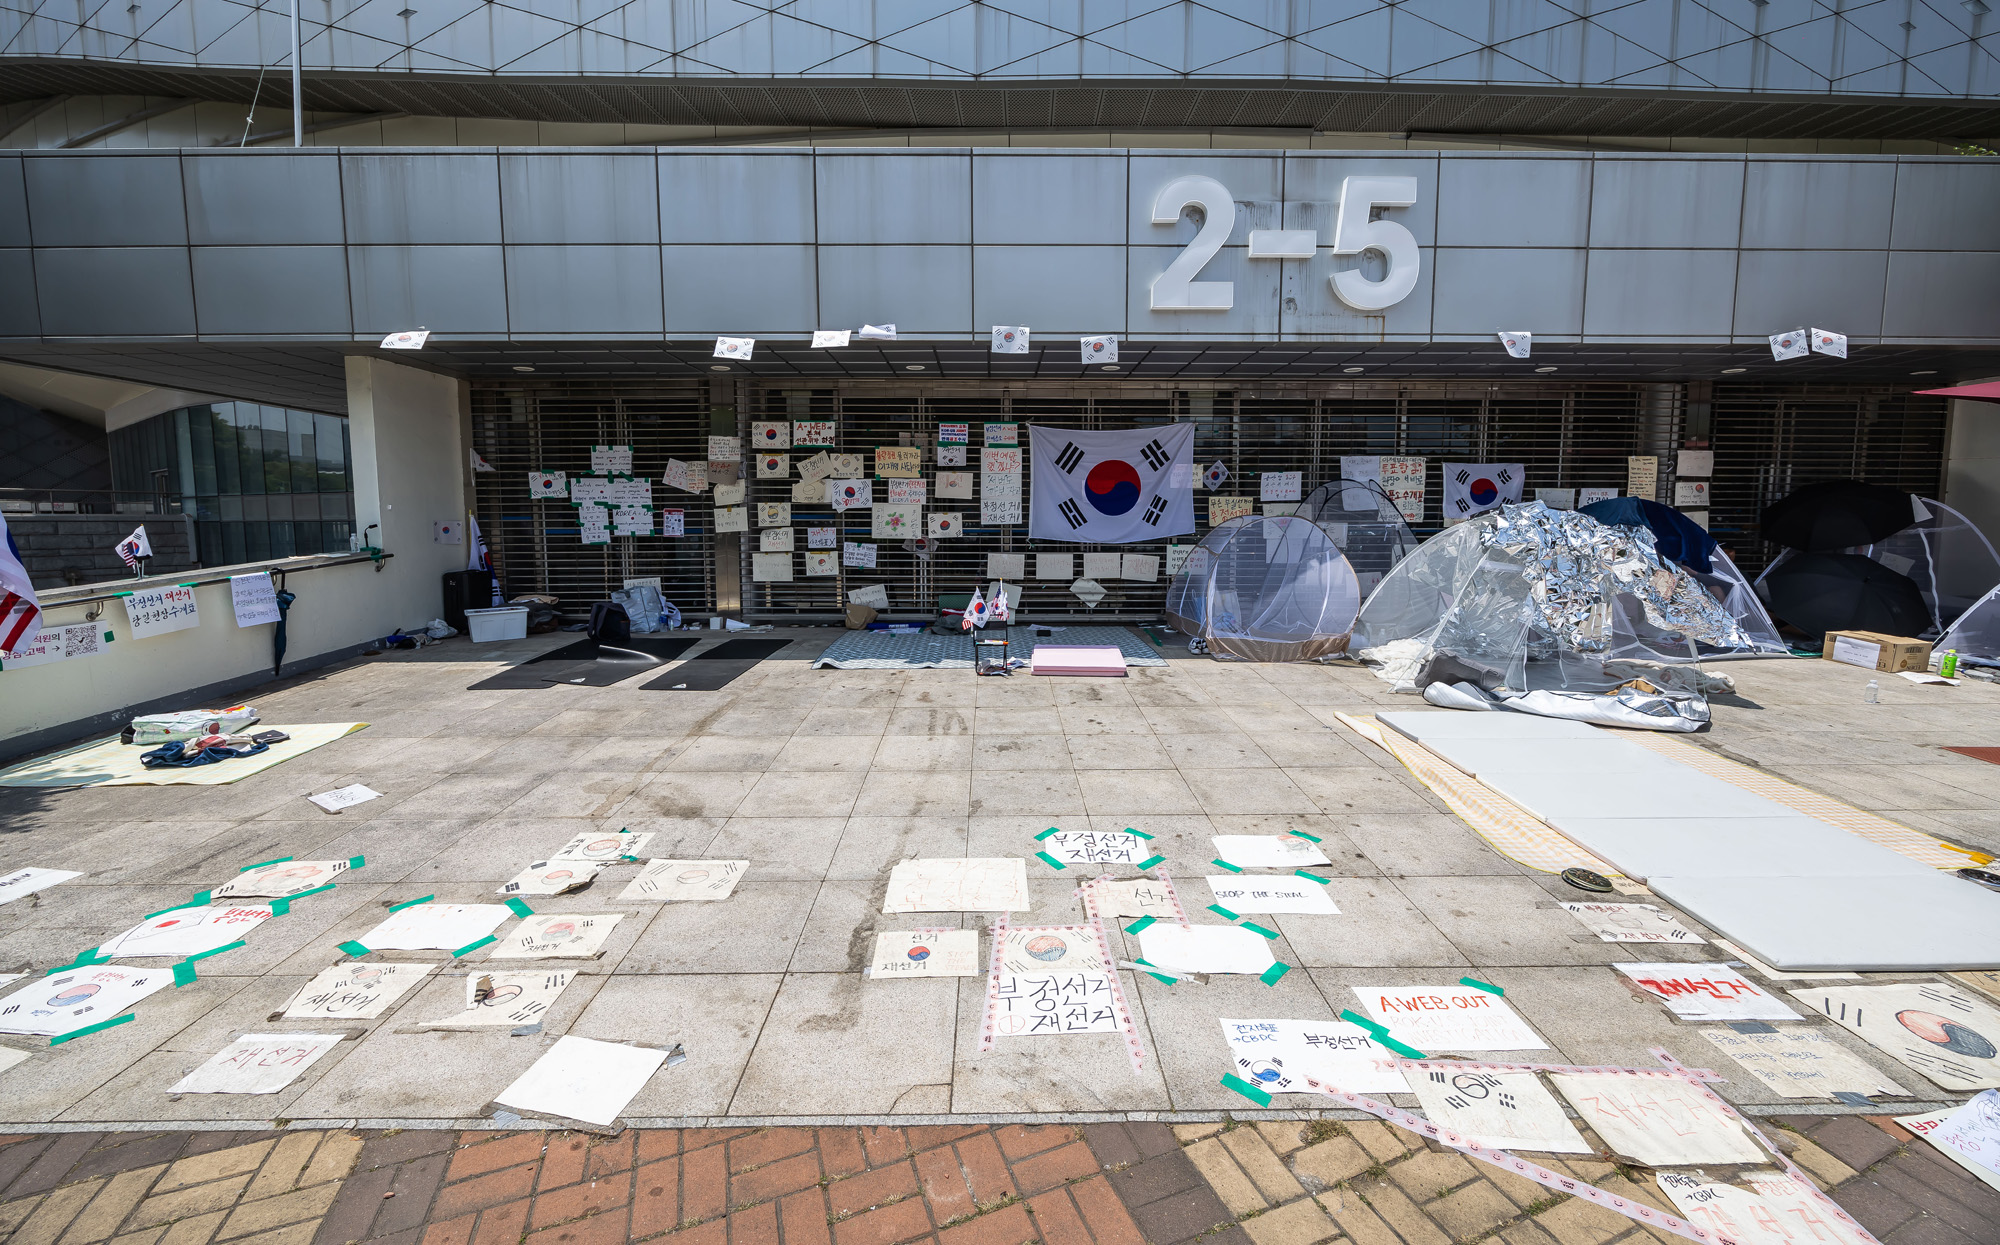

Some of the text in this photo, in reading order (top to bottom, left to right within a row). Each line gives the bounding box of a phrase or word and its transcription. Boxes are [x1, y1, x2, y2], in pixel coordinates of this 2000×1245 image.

[1150, 174, 1420, 311] 2-5
[127, 588, 191, 609] 부정선거 재선거
[26, 646, 46, 656] 고백
[1053, 832, 1138, 848] 부정선거
[1066, 848, 1131, 862] 재선거
[1216, 890, 1245, 899] STOP
[911, 933, 938, 943] 선거
[882, 961, 927, 971] 재선거
[998, 973, 1116, 1012] 부정선거
[302, 992, 381, 1012] 재선거
[1380, 996, 1490, 1013] A-WEB OUT
[1031, 1006, 1118, 1033] 재선거
[1241, 1033, 1278, 1044] CBDC
[1303, 1033, 1372, 1050] 부정선거
[220, 1045, 318, 1070] 재선거
[1579, 1092, 1729, 1136] 재선거
[1694, 1188, 1725, 1202] CBDC
